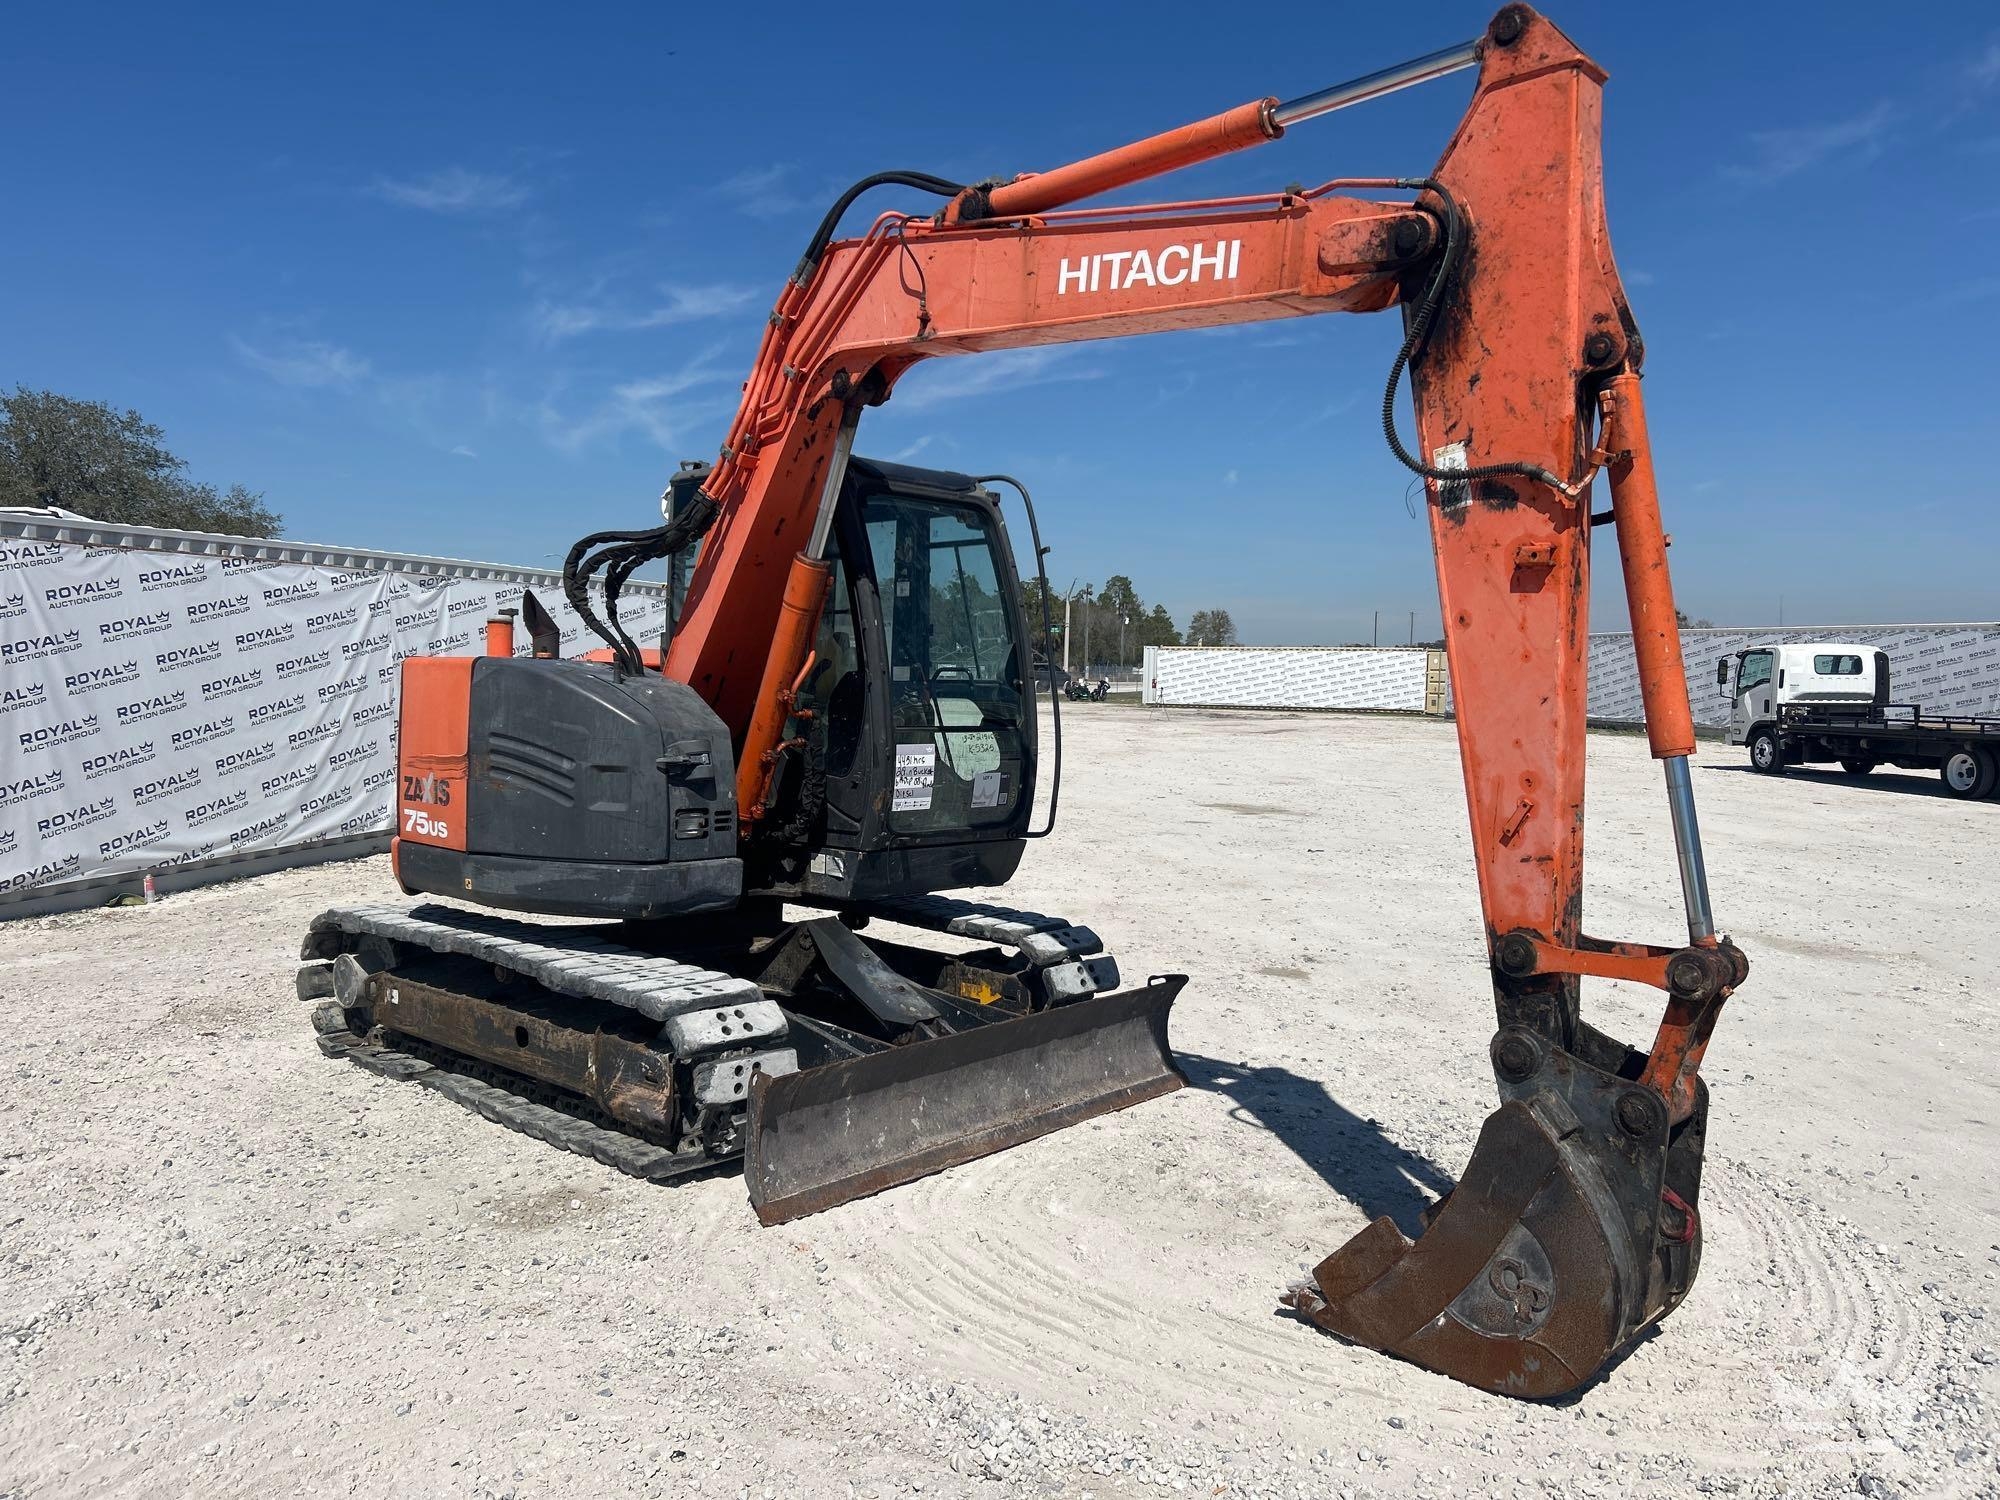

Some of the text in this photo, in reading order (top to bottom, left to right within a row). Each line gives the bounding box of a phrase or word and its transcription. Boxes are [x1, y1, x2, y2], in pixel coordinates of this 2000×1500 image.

[1058, 240, 1241, 294] HITACHI
[30, 556, 63, 566] GROUP
[139, 567, 192, 584] ROYAL
[224, 567, 256, 577] AUCTION
[331, 570, 368, 586] ROYAL
[45, 582, 105, 600] ROYAL
[142, 576, 208, 592] AUCTION GROUP
[264, 584, 306, 600] ROYAL
[333, 578, 380, 592] AUCTION GROUP
[495, 587, 523, 600] ROYAL
[48, 591, 122, 609] AUCTION GROUP
[187, 599, 235, 616] ROYAL
[266, 592, 319, 607] AUCTION GROUP
[448, 599, 478, 612] ROYAL
[190, 607, 249, 624] AUCTION GROUP
[307, 611, 346, 627] ROYAL
[395, 612, 429, 626] ROYAL
[620, 608, 640, 619] ROYAL
[99, 616, 155, 635] ROYAL
[102, 624, 172, 643] AUCTION GROUP
[309, 618, 357, 634] AUCTION GROUP
[640, 627, 660, 638] ROYAL
[1, 635, 64, 656] ROYAL
[236, 627, 281, 645] ROYAL
[238, 634, 294, 652] AUCTION GROUP
[343, 638, 378, 654] ROYAL
[428, 635, 460, 650] ROYAL
[4, 643, 82, 665] AUCTION GROUP
[156, 645, 206, 665] ROYAL
[344, 644, 389, 661] AUCTION GROUP
[159, 653, 221, 673] AUCTION GROUP
[276, 655, 318, 673] ROYAL
[278, 661, 330, 680] AUCTION GROUP
[64, 666, 122, 688] ROYAL
[68, 674, 139, 696] AUCTION GROUP
[202, 674, 249, 694] ROYAL
[204, 681, 262, 701] AUCTION GROUP
[318, 679, 357, 697] ROYAL
[320, 685, 368, 704] AUCTION GROUP
[11, 697, 47, 711] GROUP
[117, 696, 171, 718] ROYAL
[120, 702, 187, 726] AUCTION GROUP
[249, 699, 293, 719] ROYAL
[354, 703, 388, 721] ROYAL
[251, 705, 306, 726] AUCTION GROUP
[354, 716, 379, 728] AUCTION
[20, 721, 82, 745] ROYAL
[23, 728, 100, 754] AUCTION GROUP
[171, 722, 220, 744] ROYAL
[174, 728, 235, 752] AUCTION GROUP
[289, 724, 330, 744] ROYAL
[290, 729, 342, 751] AUCTION GROUP
[82, 748, 139, 772] ROYAL
[216, 747, 262, 770] ROYAL
[218, 753, 275, 777] AUCTION GROUP
[330, 746, 367, 765] ROYAL
[331, 750, 378, 772] AUCTION GROUP
[85, 754, 155, 780] AUCTION GROUP
[30, 783, 65, 798] GROUP
[133, 774, 186, 799] ROYAL
[261, 770, 305, 791] ROYAL
[264, 774, 318, 798] AUCTION GROUP
[365, 781, 389, 794] AUCTION
[404, 772, 450, 806] ZAXIS
[136, 779, 201, 806] AUCTION GROUP
[300, 791, 340, 813] ROYAL
[38, 804, 99, 832] ROYAL
[186, 796, 234, 821] ROYAL
[188, 801, 248, 828] AUCTION GROUP
[302, 796, 352, 820] AUCTION GROUP
[41, 809, 117, 840] AUCTION GROUP
[230, 819, 275, 843] ROYAL
[341, 810, 378, 832] ROYAL
[99, 827, 154, 854] ROYAL
[232, 823, 287, 850] AUCTION GROUP
[102, 843, 141, 862] AUCTION
[142, 832, 170, 846] GROUP
[47, 866, 80, 882] GROUP
